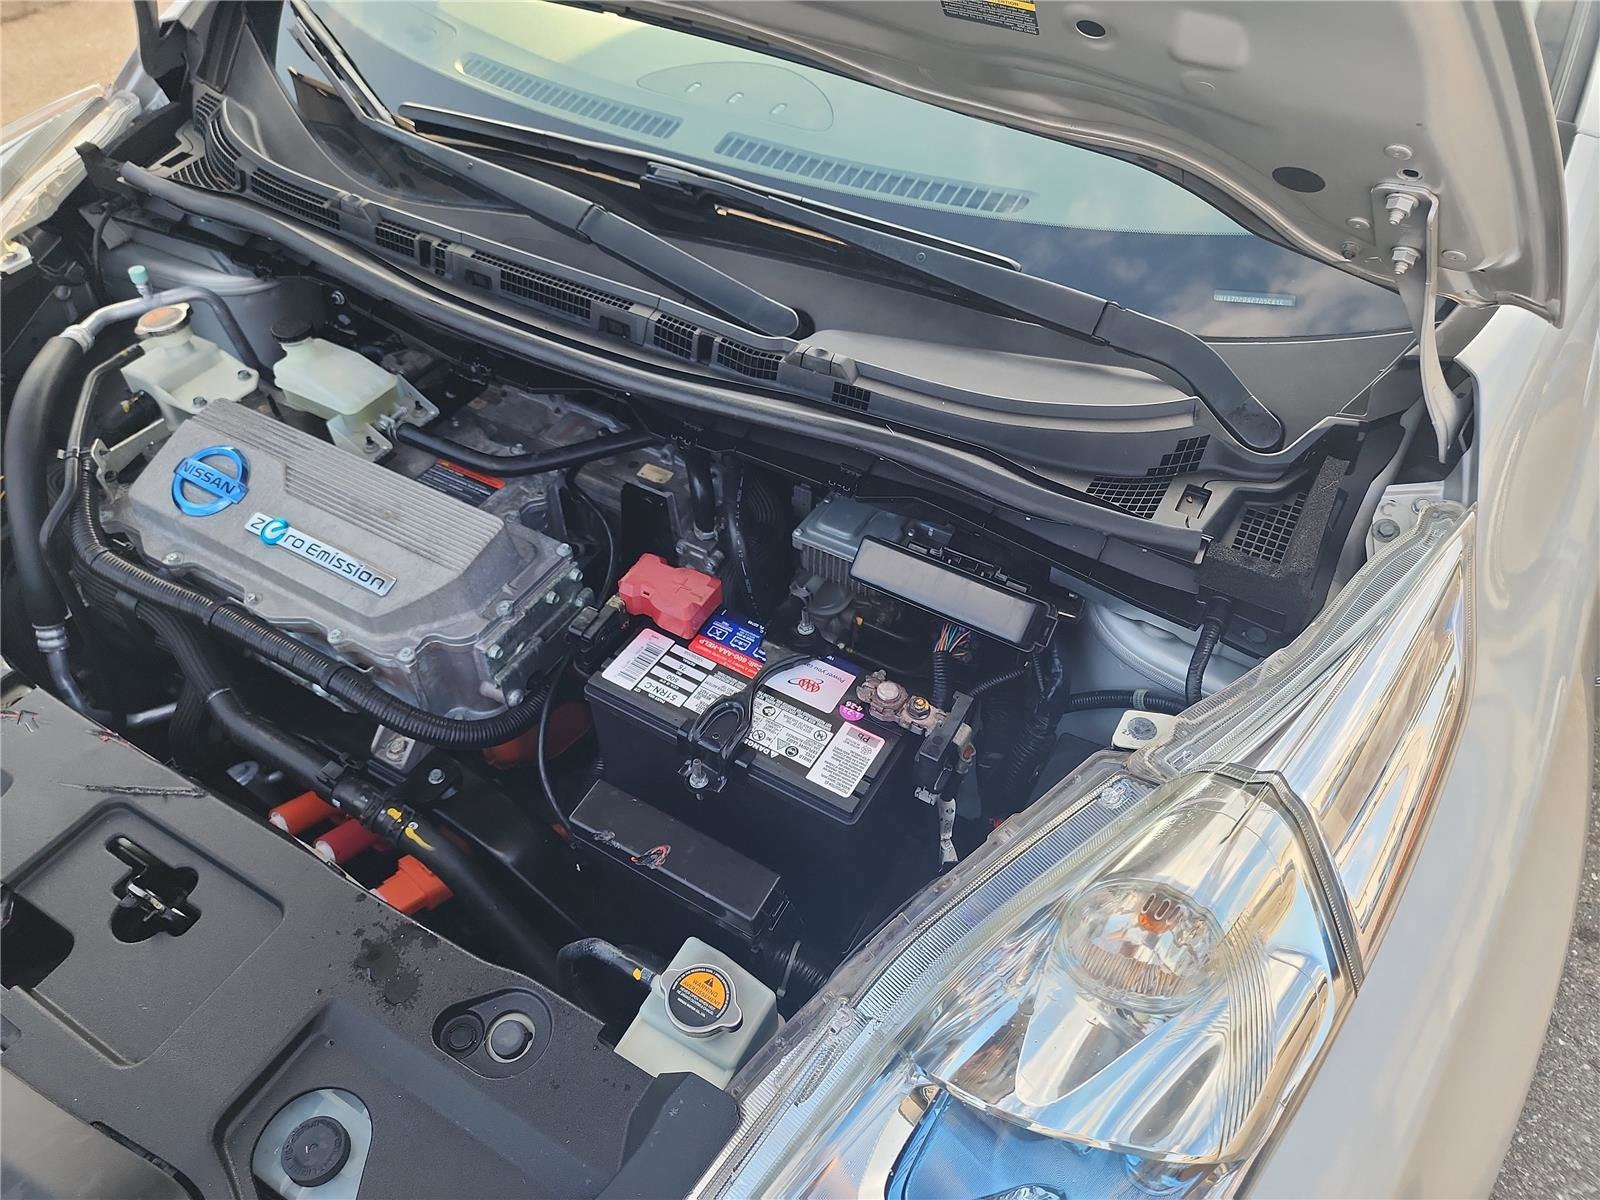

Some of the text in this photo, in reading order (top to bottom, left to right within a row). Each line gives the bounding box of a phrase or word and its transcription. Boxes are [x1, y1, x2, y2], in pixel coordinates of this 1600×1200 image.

[182, 461, 236, 495] NISSAN
[306, 543, 386, 590] Emission
[643, 681, 678, 702] 51RN-C
[799, 679, 820, 691] AAA
[858, 733, 870, 742] Pb
[743, 739, 770, 755] DANGE
[692, 980, 718, 997] WARNING
